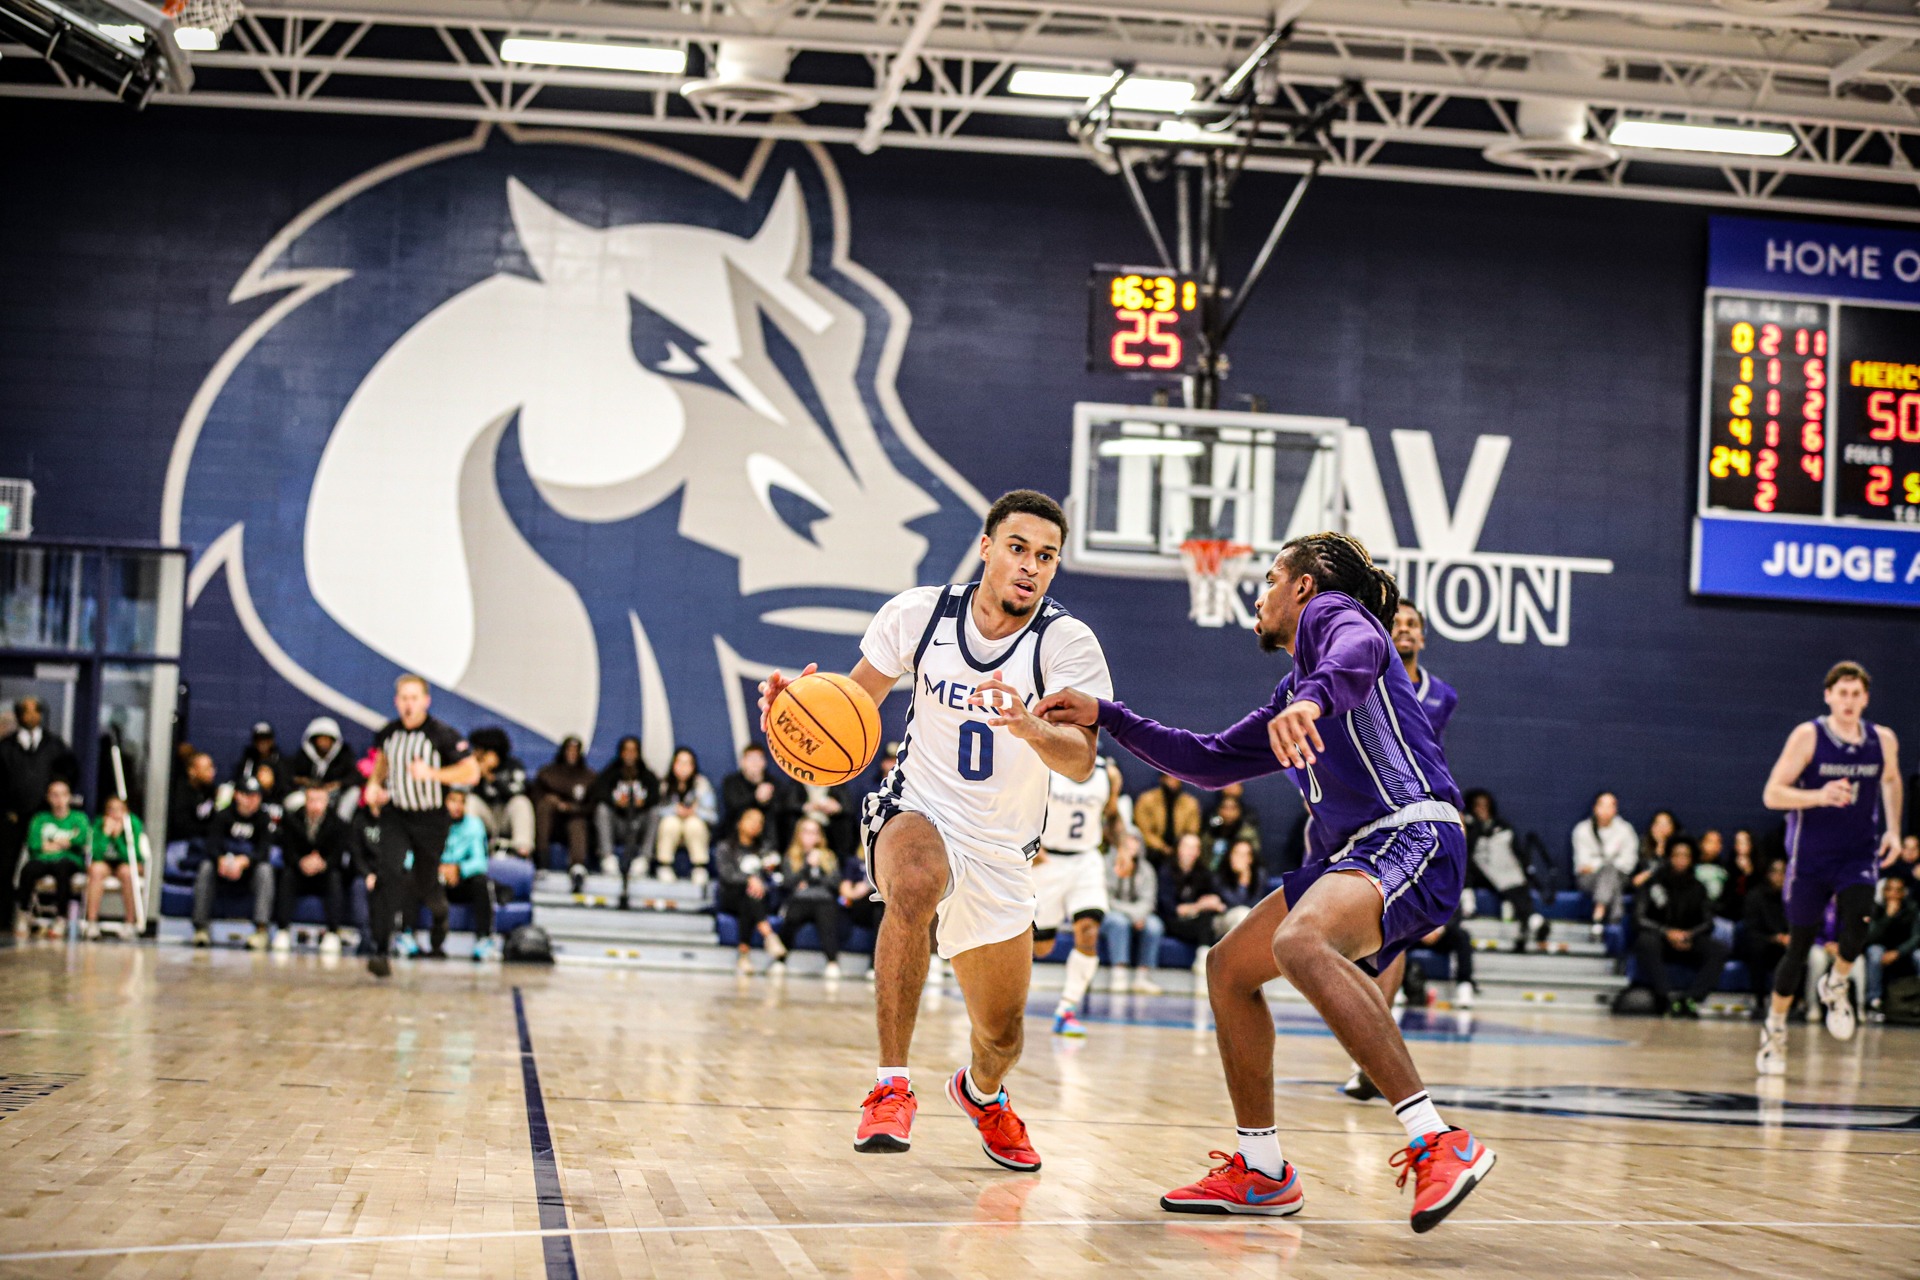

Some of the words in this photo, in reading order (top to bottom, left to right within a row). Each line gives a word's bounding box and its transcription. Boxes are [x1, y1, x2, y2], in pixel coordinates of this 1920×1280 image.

[1766, 239, 1881, 280] HOME
[1111, 309, 1182, 368] 25
[1731, 322, 1754, 353] 0
[1759, 324, 1782, 355] 2
[1796, 329, 1827, 356] 11
[1740, 356, 1754, 382] 1
[1767, 358, 1781, 384] 1
[1803, 358, 1826, 389] 5
[1851, 360, 1920, 390] MERC
[1729, 384, 1753, 416] 2
[1766, 389, 1780, 416] 1
[1802, 390, 1825, 421] 2
[1868, 391, 1920, 443] 50
[1729, 417, 1752, 445] 4
[1765, 420, 1779, 447] 1
[1802, 421, 1825, 452] 6
[1709, 446, 1751, 478] 24
[1755, 449, 1779, 480] 2
[1801, 454, 1824, 481] 4
[1754, 481, 1778, 512] 2
[1866, 465, 1892, 506] 2
[1762, 541, 1896, 583] JUDGE
[775, 710, 820, 755] NCAA
[958, 720, 994, 781] 0
[1069, 811, 1085, 838] 2
